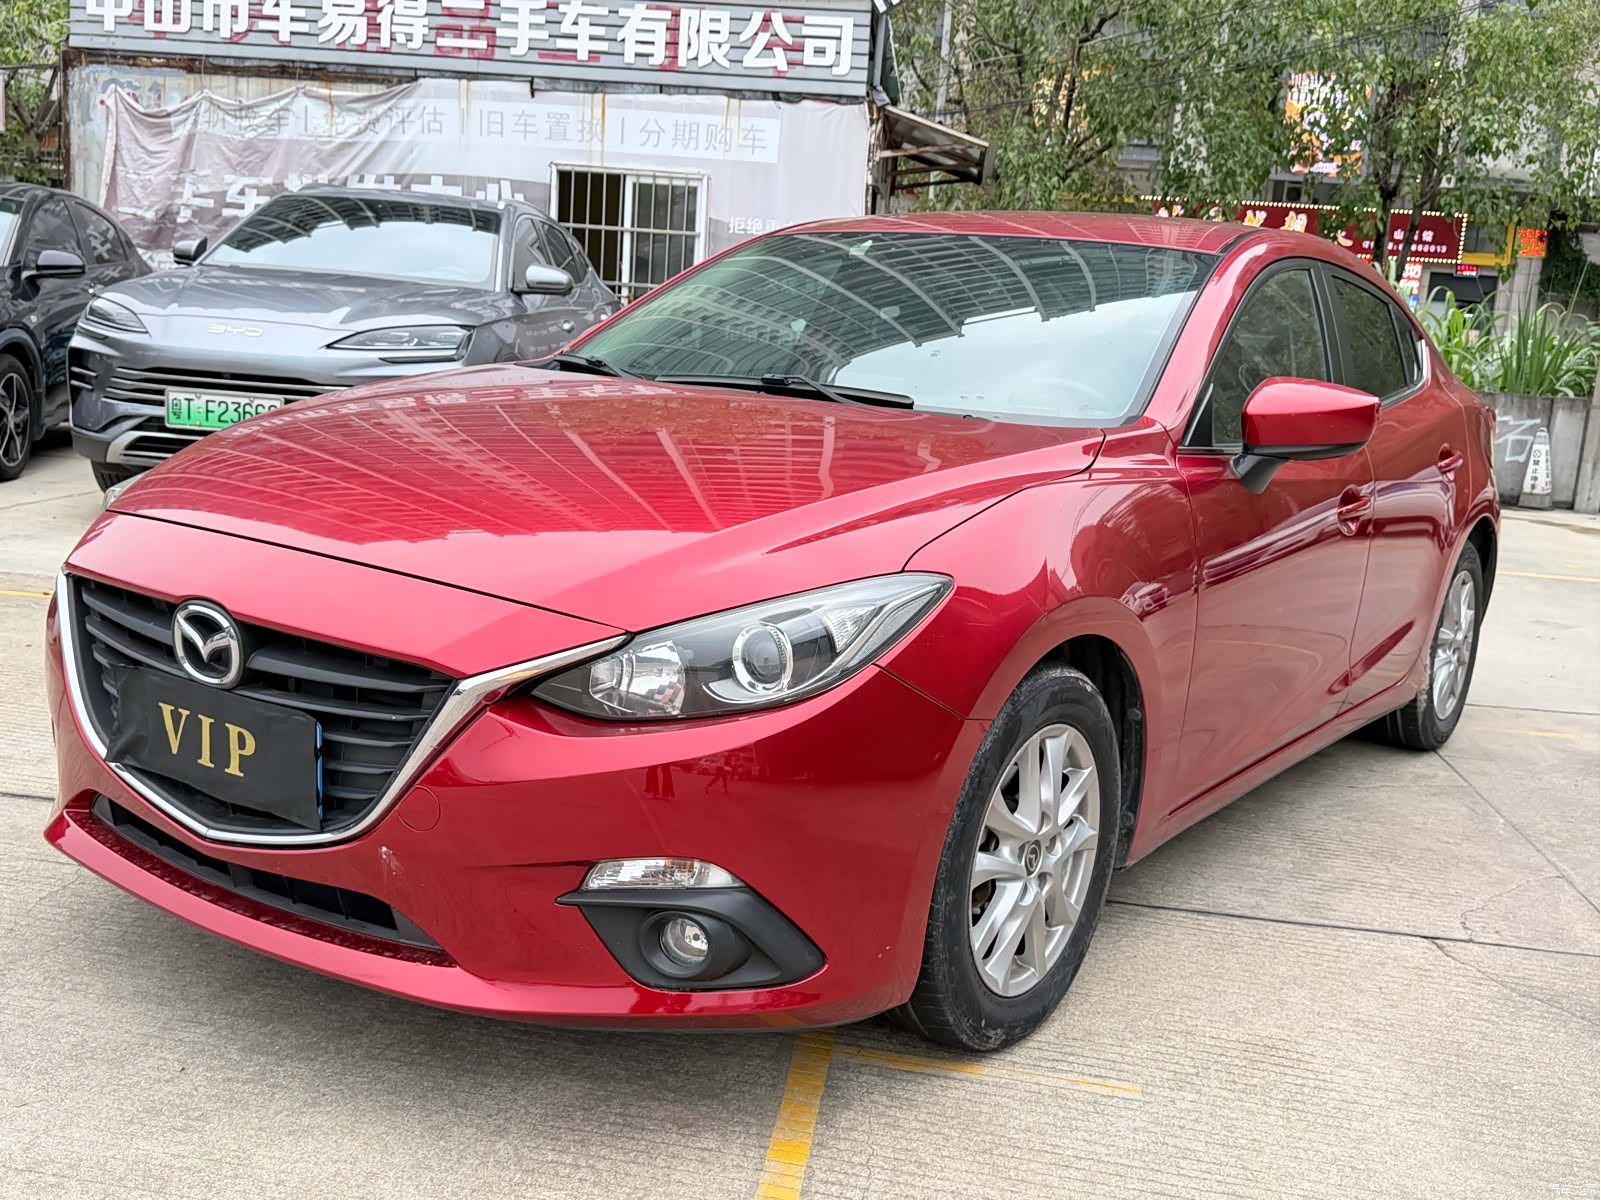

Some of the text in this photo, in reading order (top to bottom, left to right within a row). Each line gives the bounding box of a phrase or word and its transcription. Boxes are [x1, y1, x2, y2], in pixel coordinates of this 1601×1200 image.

[478, 109, 602, 144] 旧车置换
[639, 116, 768, 155] 分期购车
[208, 324, 264, 337] BYD
[158, 702, 256, 778] VIP
